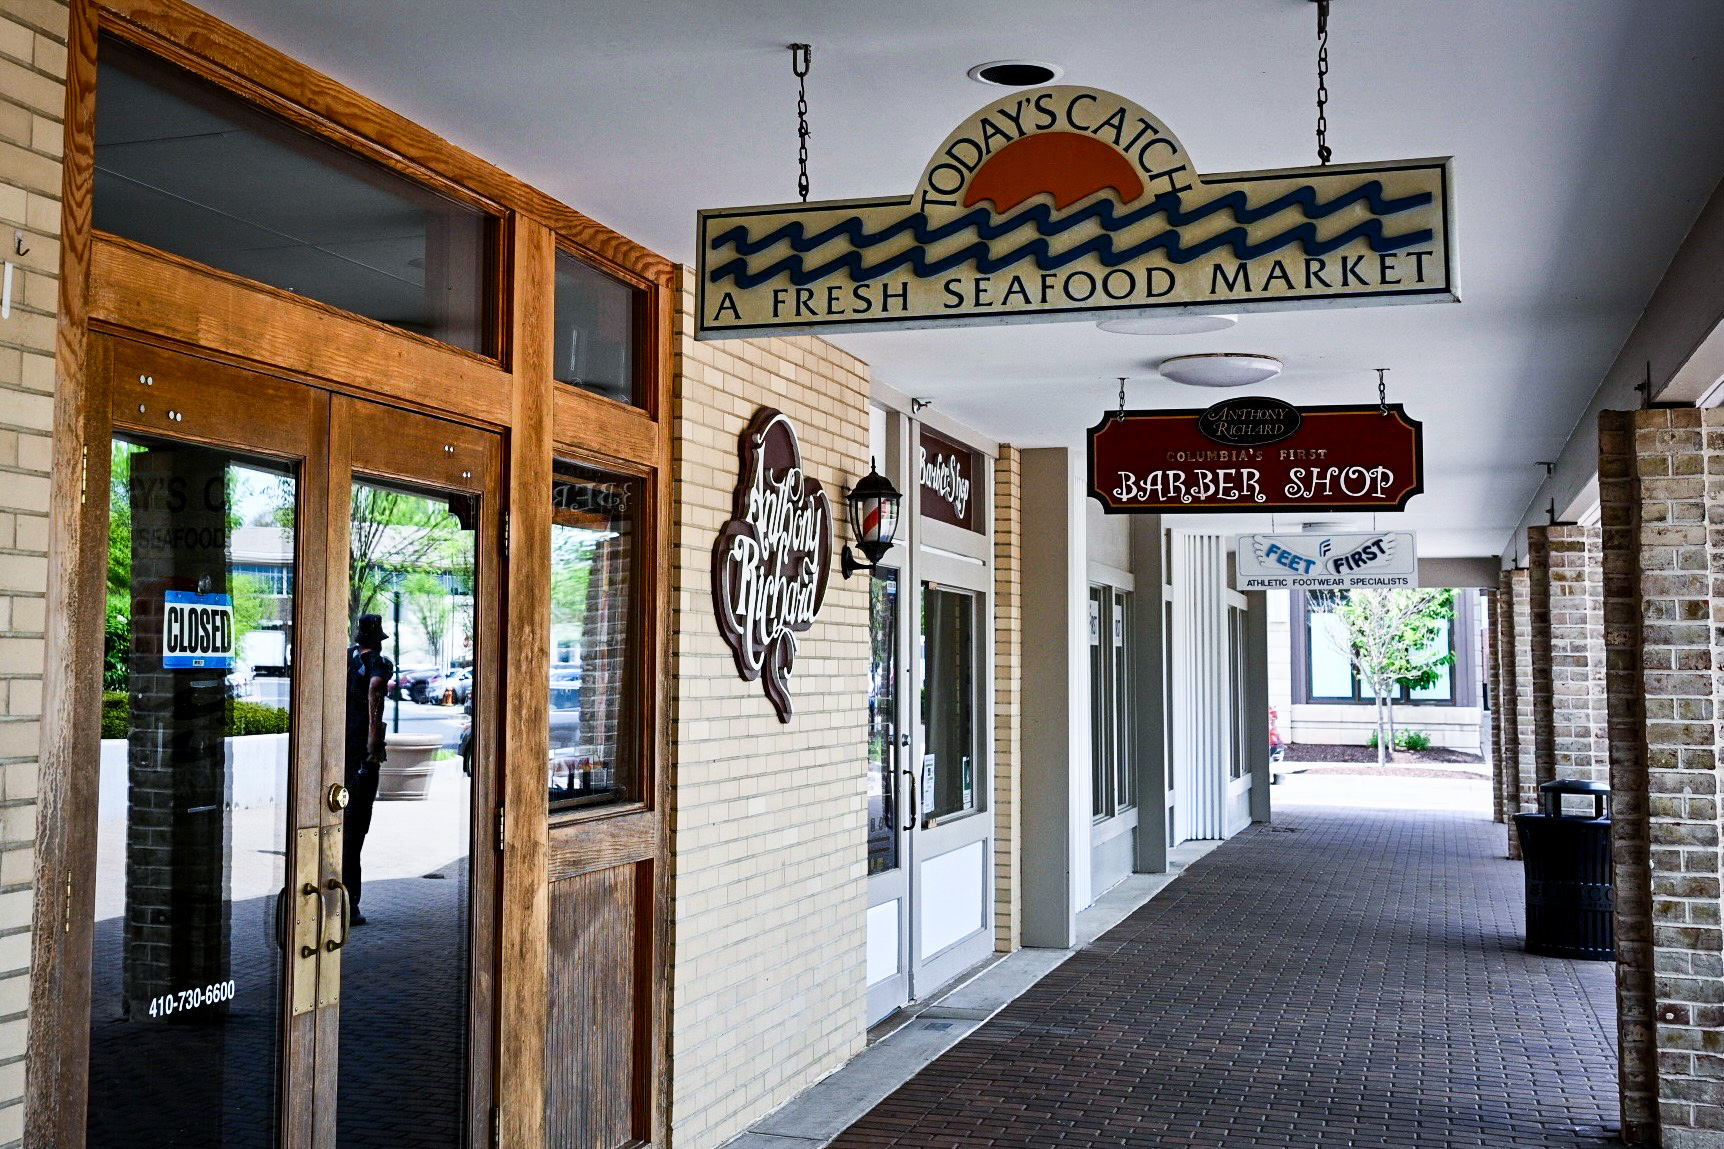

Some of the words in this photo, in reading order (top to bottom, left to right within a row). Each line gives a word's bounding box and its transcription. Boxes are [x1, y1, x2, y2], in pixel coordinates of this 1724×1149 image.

[921, 93, 1057, 212] TODAY'S
[1065, 93, 1193, 202] CATCH
[713, 292, 742, 321] A
[772, 281, 909, 317] FRESH
[943, 267, 1176, 309] SEAFOOD
[1209, 250, 1434, 295] MARKET
[1207, 406, 1289, 420] ANTHONY
[1213, 421, 1285, 439] RICHARD
[1166, 448, 1263, 462] COLUMBIA'S
[1279, 449, 1328, 460] FIRST
[746, 413, 831, 569] Anthony
[948, 454, 970, 520] Shop
[1112, 468, 1266, 503] BARBER
[1284, 465, 1394, 498] SHOP
[1265, 543, 1317, 575] FEET
[1332, 538, 1387, 574] FIRST
[1246, 578, 1288, 587] ATHLETIC
[1292, 578, 1344, 586] FOOTWEAR
[1349, 577, 1409, 586] SPECIALISTS
[726, 533, 820, 672] Richard
[166, 606, 232, 654] CLOSED
[148, 979, 236, 1018] 410-730-6600
